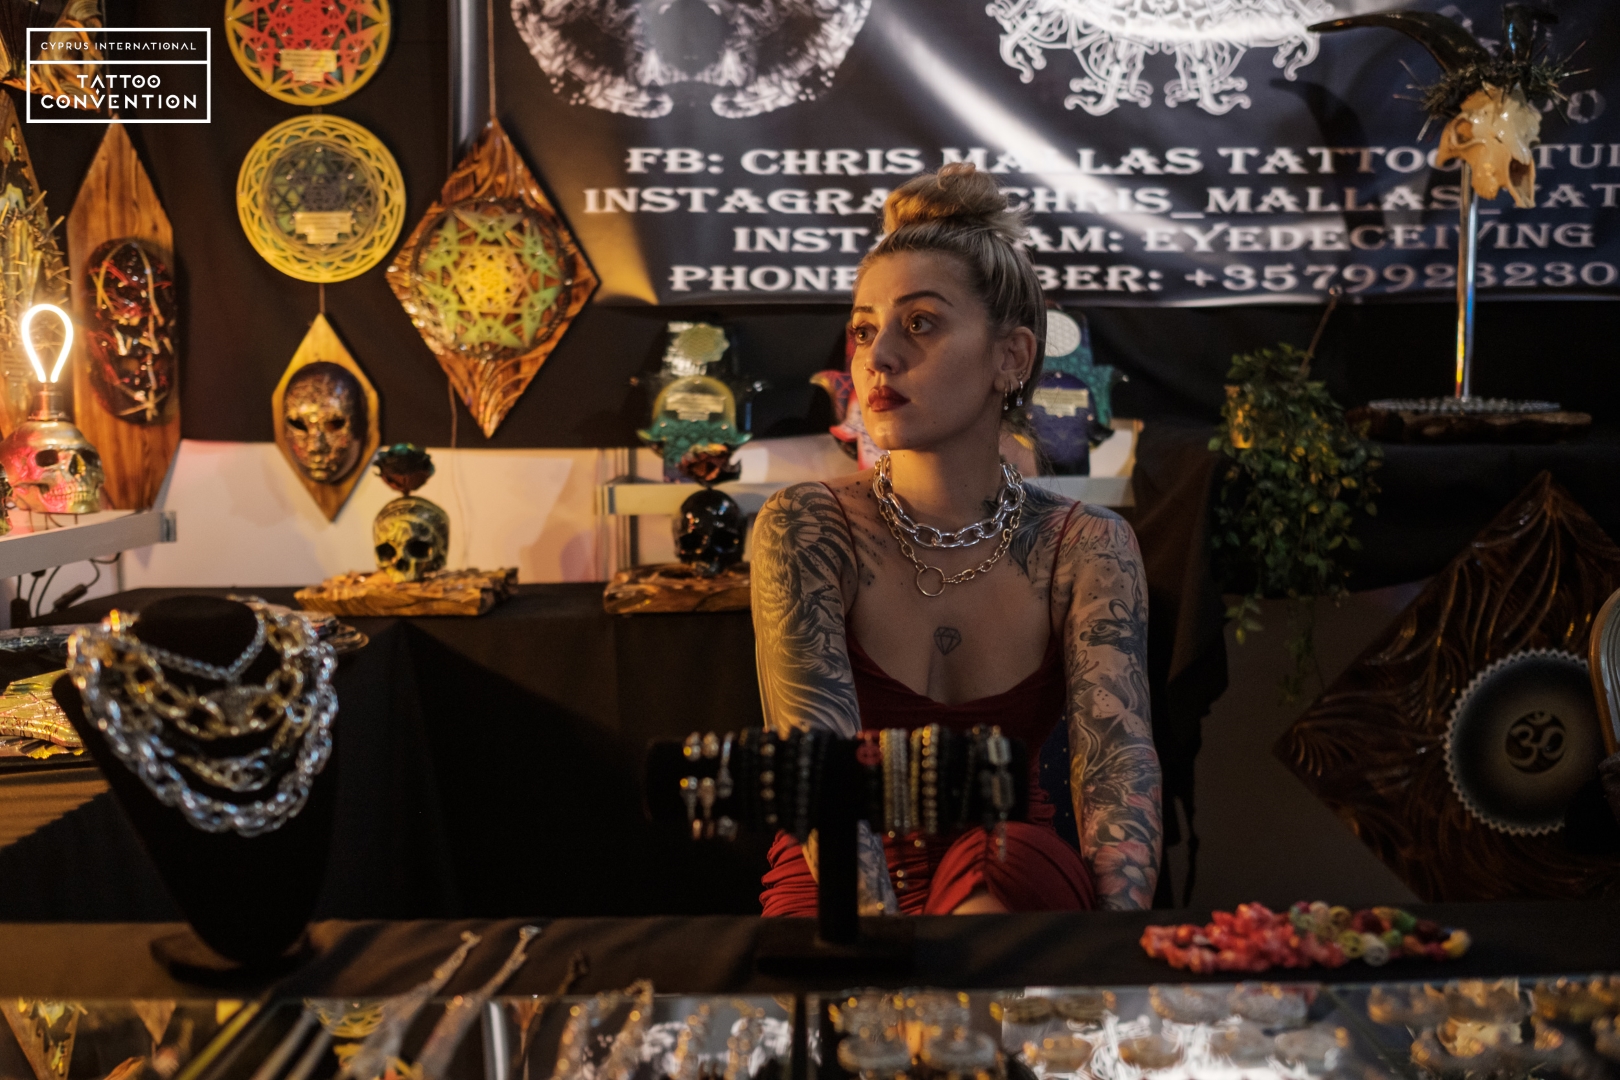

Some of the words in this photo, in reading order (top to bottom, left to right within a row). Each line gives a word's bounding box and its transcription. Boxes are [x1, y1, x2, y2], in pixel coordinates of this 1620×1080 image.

[626, 148, 724, 174] FB:
[741, 148, 925, 175] CHRIS
[669, 265, 858, 292] PHONE
